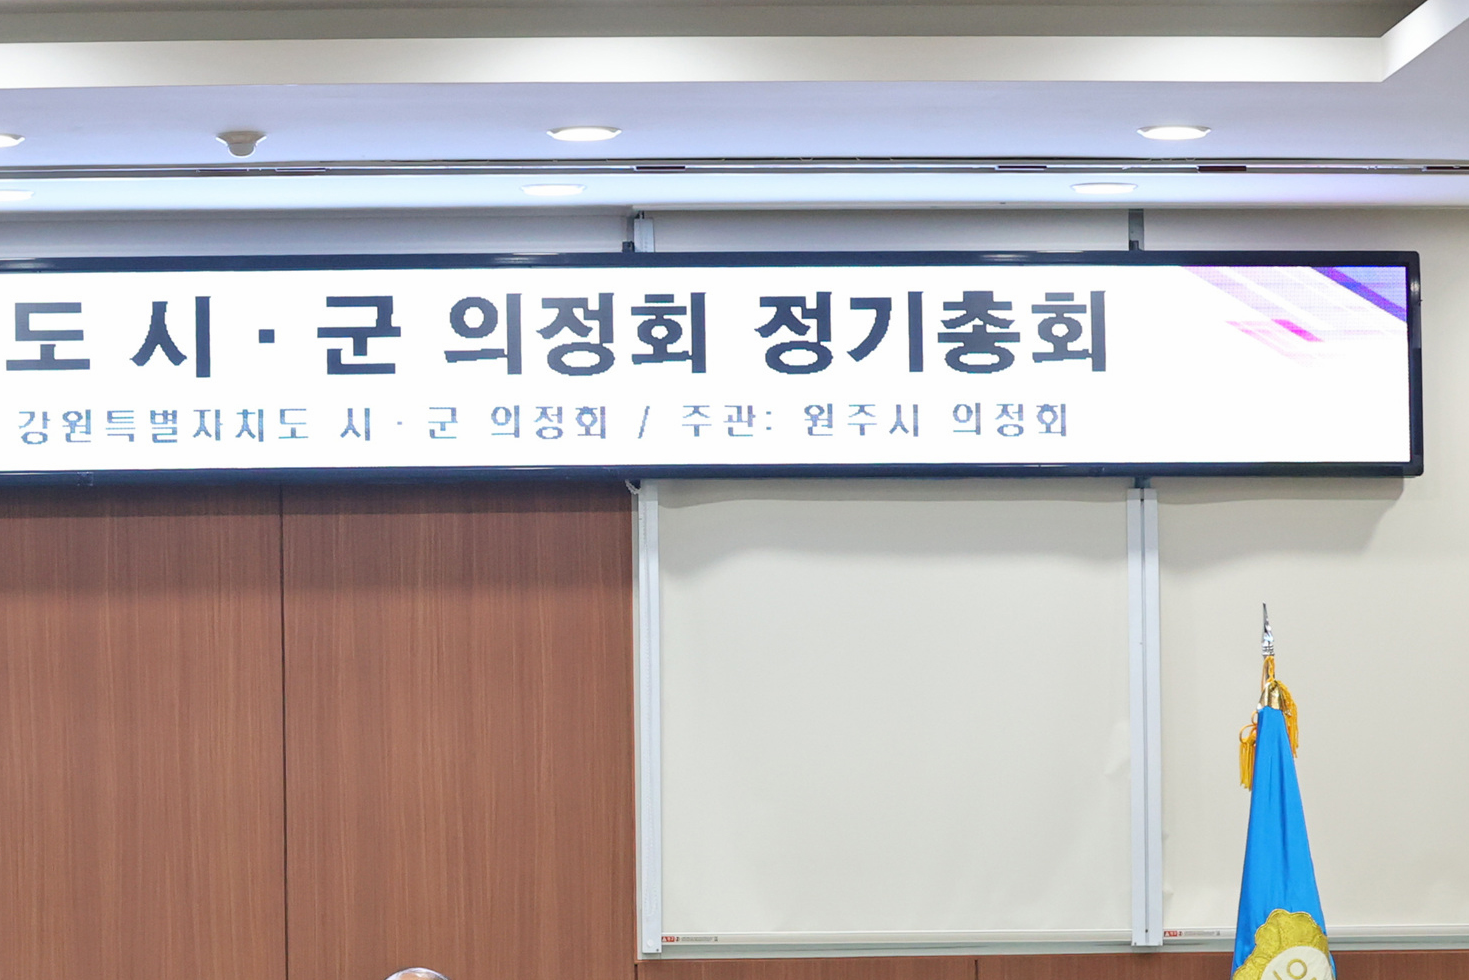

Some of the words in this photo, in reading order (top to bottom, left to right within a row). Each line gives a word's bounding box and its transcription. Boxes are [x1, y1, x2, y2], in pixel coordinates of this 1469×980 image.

[445, 293, 706, 376] 의정회
[755, 291, 1105, 374] 정기총회
[19, 409, 308, 444] 강원특별자치도
[491, 405, 605, 439] 의정회
[683, 406, 771, 437] 주관:
[804, 404, 918, 437] 원주시
[953, 403, 1066, 436] 의정회
